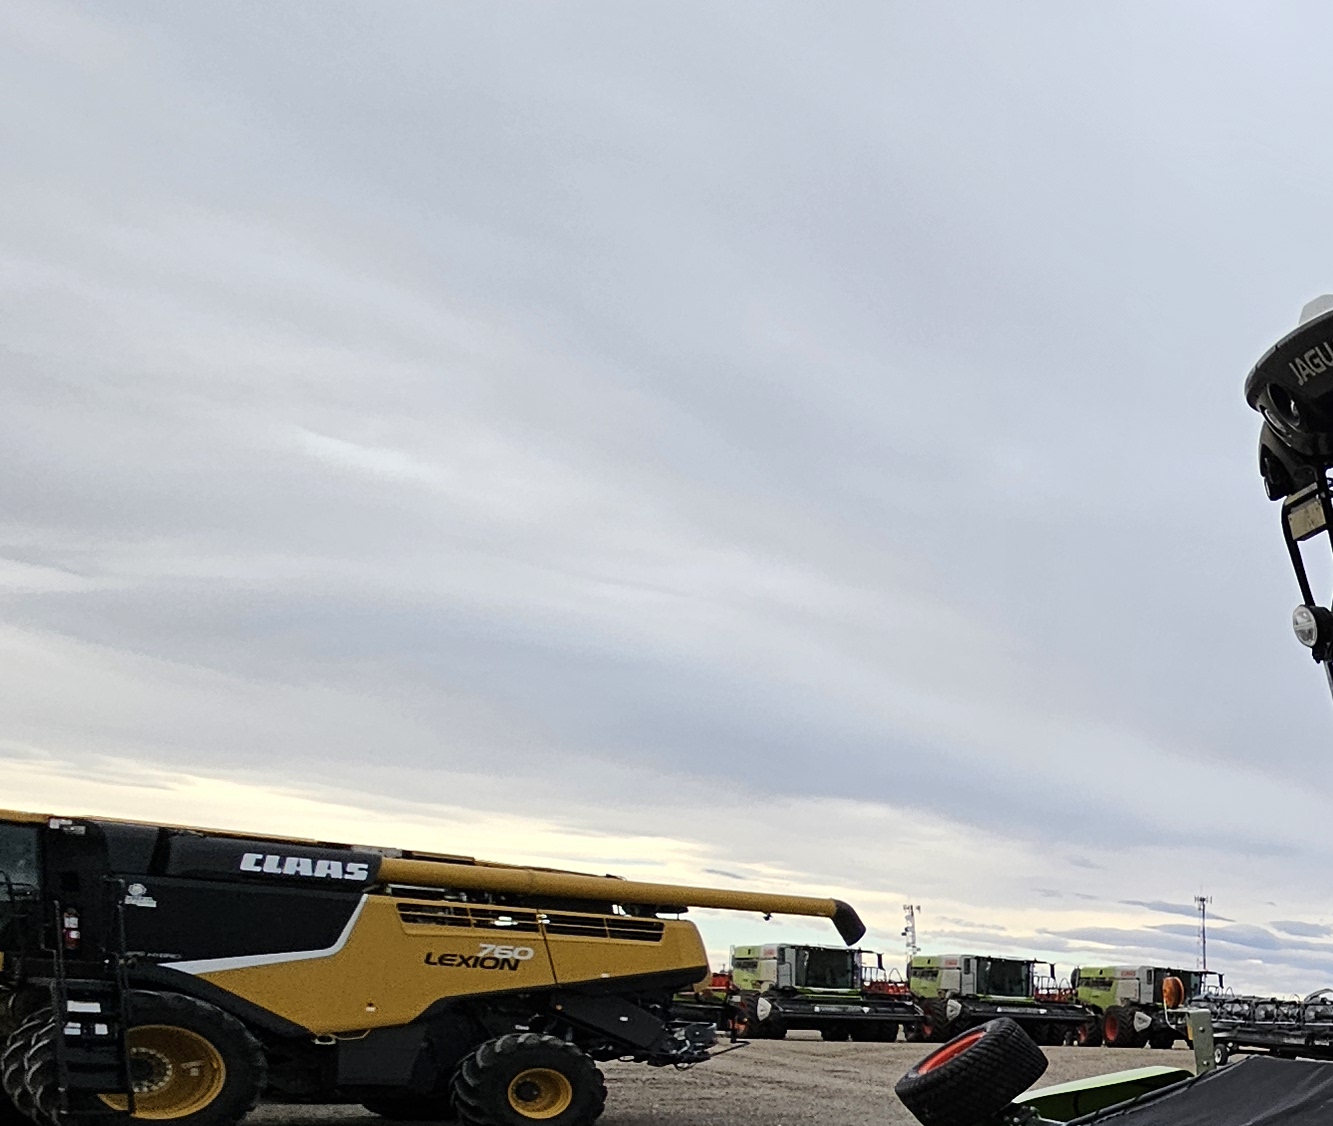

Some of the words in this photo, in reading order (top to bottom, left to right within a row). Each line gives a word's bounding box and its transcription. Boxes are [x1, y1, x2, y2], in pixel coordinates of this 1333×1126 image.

[239, 852, 370, 881] CLAAS
[423, 951, 521, 972] LEXION
[477, 943, 535, 961] 760
